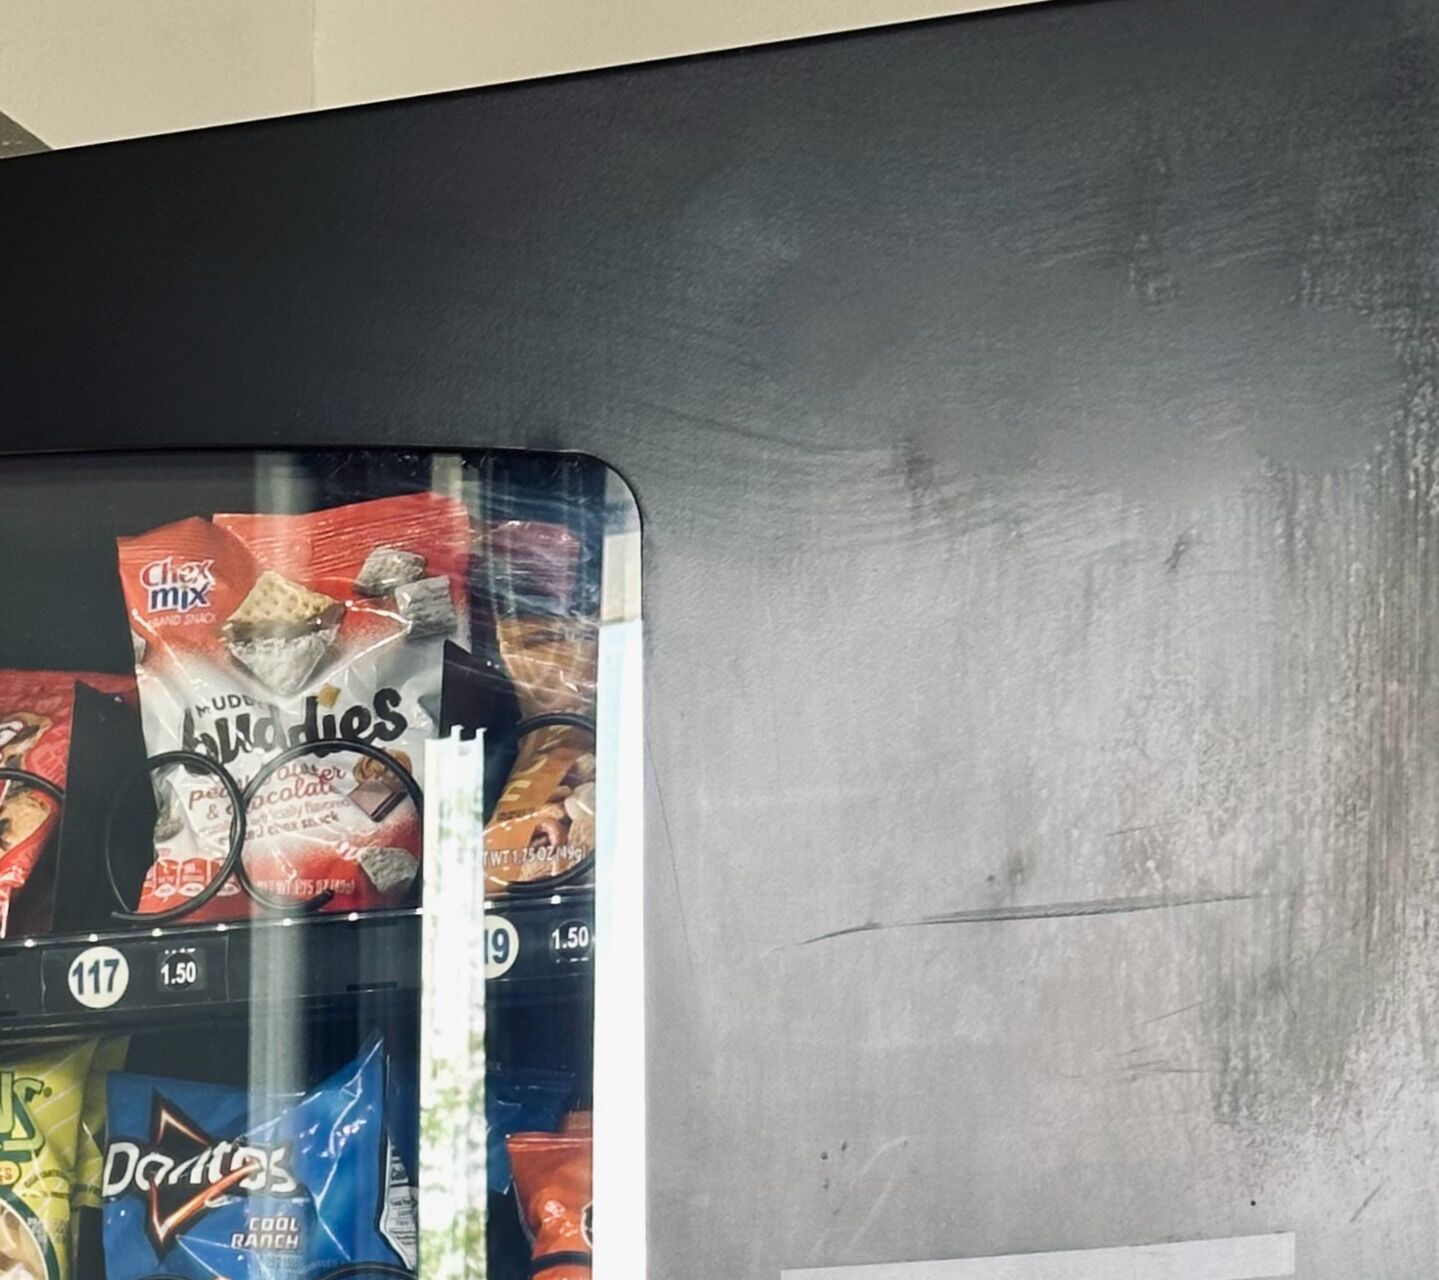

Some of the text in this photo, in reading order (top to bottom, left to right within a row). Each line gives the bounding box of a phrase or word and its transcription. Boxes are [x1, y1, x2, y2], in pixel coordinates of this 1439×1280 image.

[551, 926, 589, 951] 1.50
[71, 960, 121, 997] 117
[161, 964, 197, 985] 1.50
[102, 1140, 298, 1197] Doritos
[249, 1216, 299, 1232] COOL
[230, 1233, 299, 1250] RANCH
